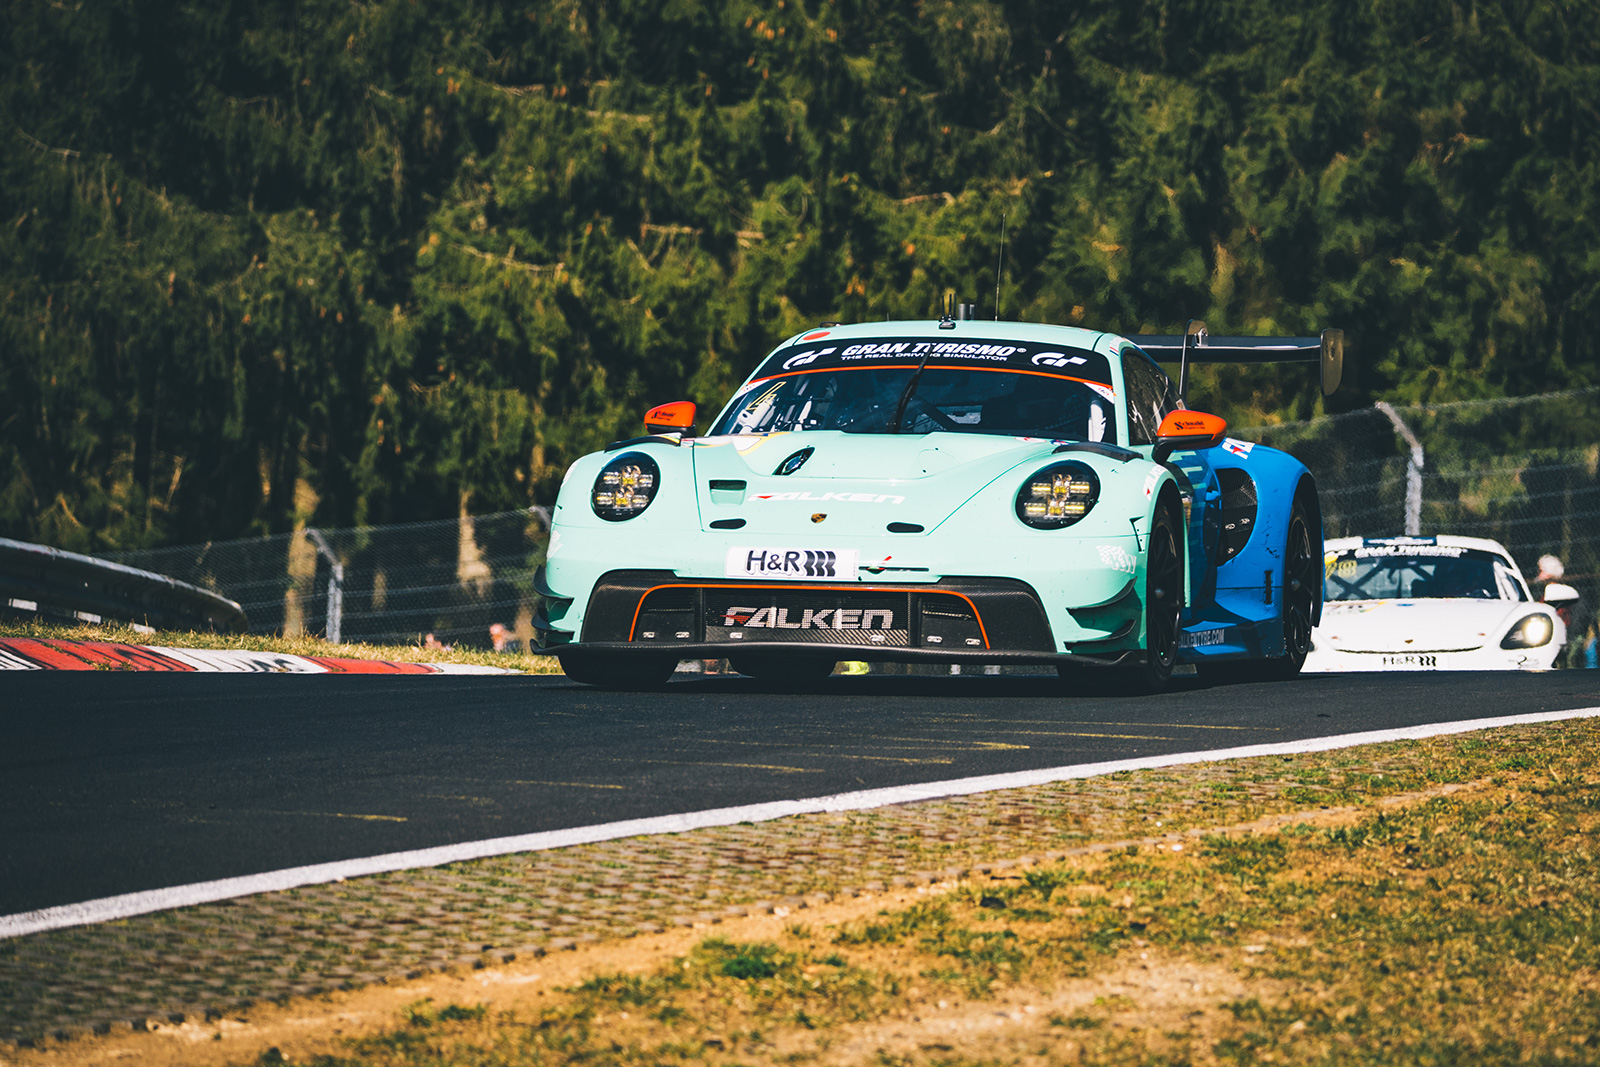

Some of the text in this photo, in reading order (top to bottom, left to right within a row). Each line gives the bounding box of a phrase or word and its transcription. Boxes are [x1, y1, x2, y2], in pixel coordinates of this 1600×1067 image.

[841, 342, 912, 356] GRAN
[943, 353, 1008, 361] SIMULATOR
[748, 492, 906, 504] FALKEN
[746, 550, 800, 572] H&R
[721, 606, 893, 630] FALKEN
